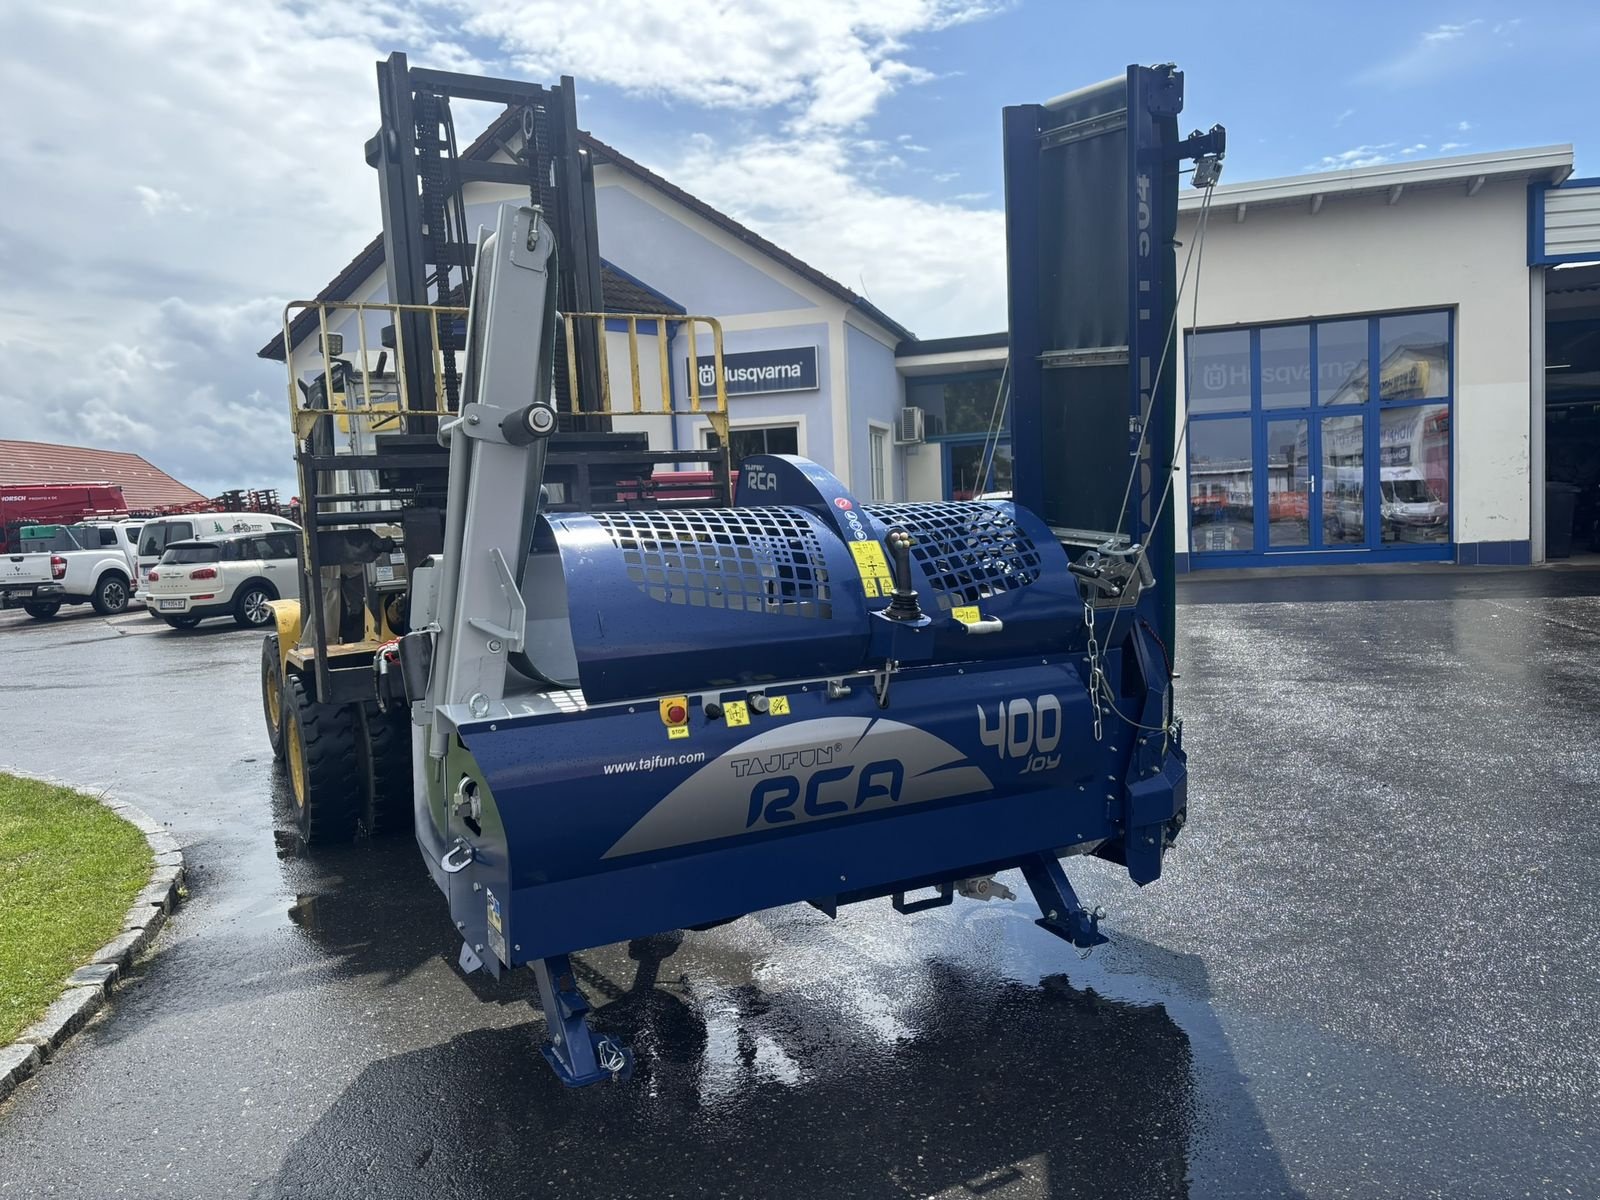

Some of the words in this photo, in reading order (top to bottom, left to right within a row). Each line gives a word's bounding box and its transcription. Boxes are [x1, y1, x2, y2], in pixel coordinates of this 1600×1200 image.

[1230, 360, 1358, 386] Hsqvarna
[747, 471, 777, 491] RCA
[977, 693, 1062, 760] 400
[603, 751, 706, 776] www.tajfun.com
[745, 758, 905, 829] RCA
